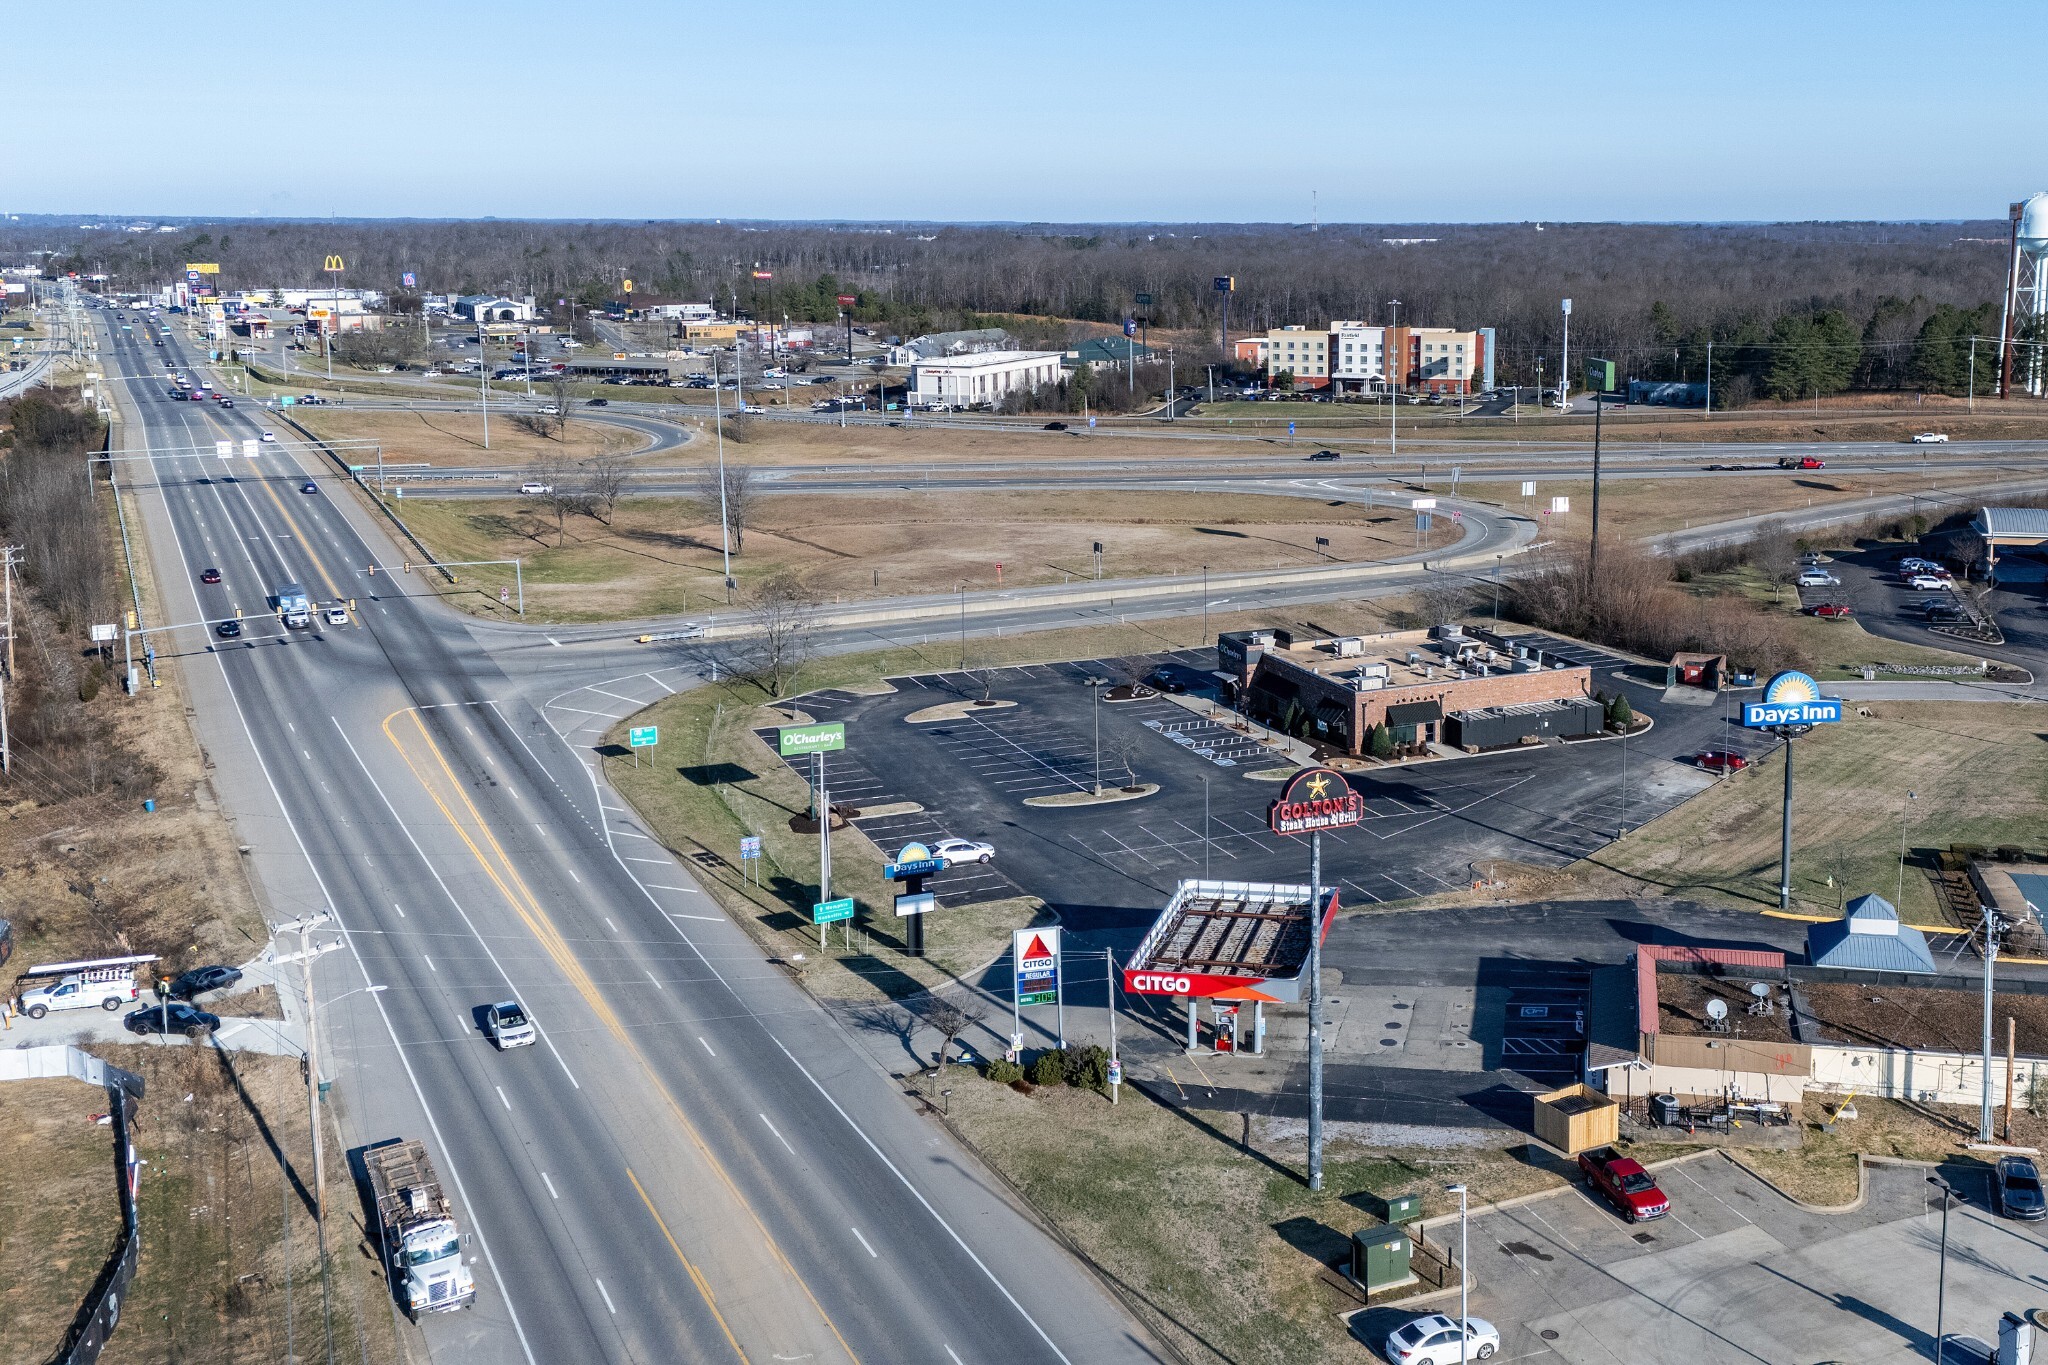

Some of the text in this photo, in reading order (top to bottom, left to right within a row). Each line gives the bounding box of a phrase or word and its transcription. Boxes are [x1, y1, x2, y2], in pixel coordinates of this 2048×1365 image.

[1750, 704, 1835, 723] Days Inn
[783, 730, 843, 747] O'Charley's
[1280, 795, 1357, 821] COLTON'S
[1280, 817, 1304, 832] Steak
[1305, 815, 1329, 829] House
[893, 861, 935, 873] Days Inn
[1023, 959, 1052, 969] CITGO
[1025, 970, 1051, 980] REGULAR
[1133, 975, 1190, 993] CITGO
